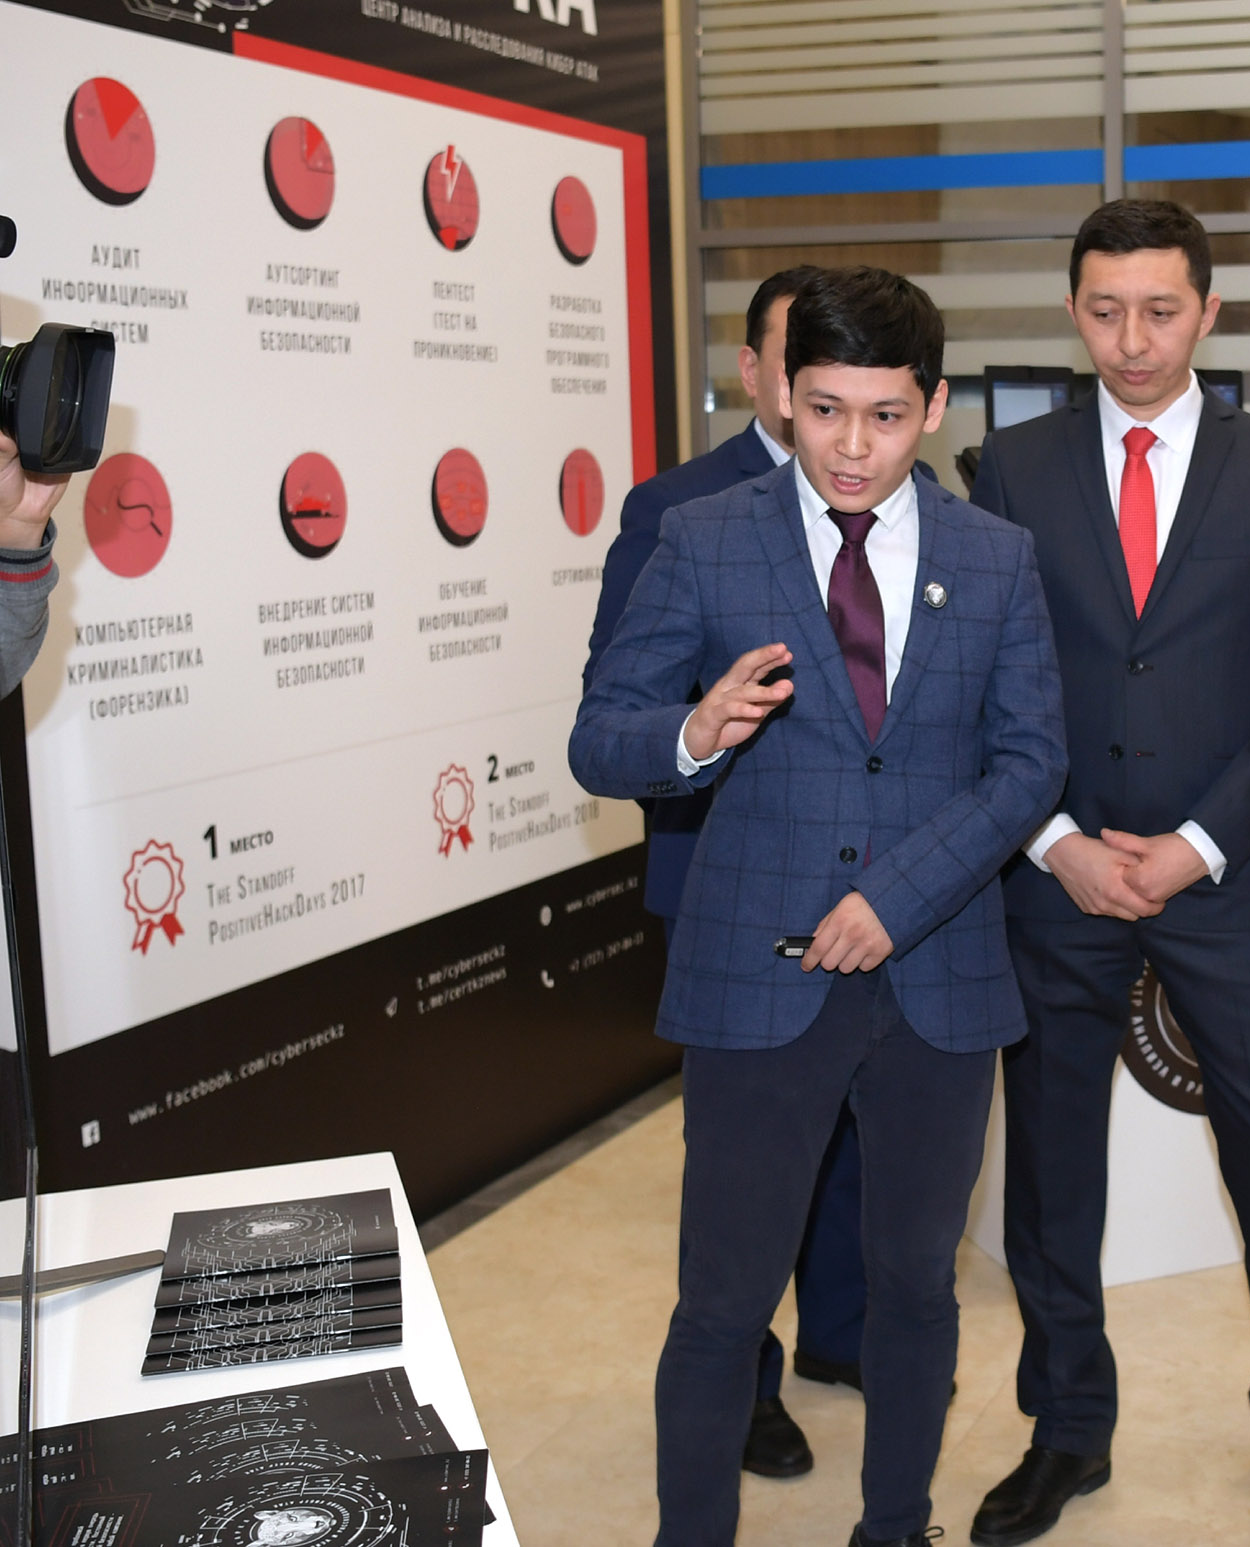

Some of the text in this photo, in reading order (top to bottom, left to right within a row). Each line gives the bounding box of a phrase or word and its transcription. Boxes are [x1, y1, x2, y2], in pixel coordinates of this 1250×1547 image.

[91, 244, 140, 269] АУДИТ
[41, 277, 189, 309] ИНФОРМАЦИОННЫХ
[433, 281, 475, 302] ПЕНТЕСТ
[247, 296, 361, 322] ИНФОРМАЦИОННОЙ
[464, 314, 477, 331] НА
[260, 330, 352, 354] БЕЗОПАСНОСТИ
[439, 579, 487, 601] ОБУЧЕНИЕ
[552, 567, 601, 586] СЕРТИФИКА
[259, 592, 375, 624] ВНЕДРЕНИЕ СИСТЕМ
[418, 602, 509, 632] ИНФОРМАЦИОННОЙ
[75, 613, 193, 646] КОМПЬЮТЕРНАЯ
[263, 620, 374, 656] ИНФОРМАЦИОННОЙ
[429, 634, 501, 663] БЕЗОПАСНОСТИ
[67, 648, 204, 686] КРИМИНАЛИСТИКА
[277, 656, 365, 689] БЕЗОПАСНОСТИ
[89, 685, 189, 720] (ФОРЕНЗИКА)
[487, 753, 535, 783] 2 МЕСТО
[203, 824, 274, 860] 1 МЕСТО
[330, 873, 365, 906] 2017
[128, 1024, 345, 1126] www.facebook.com/cyberseckz
